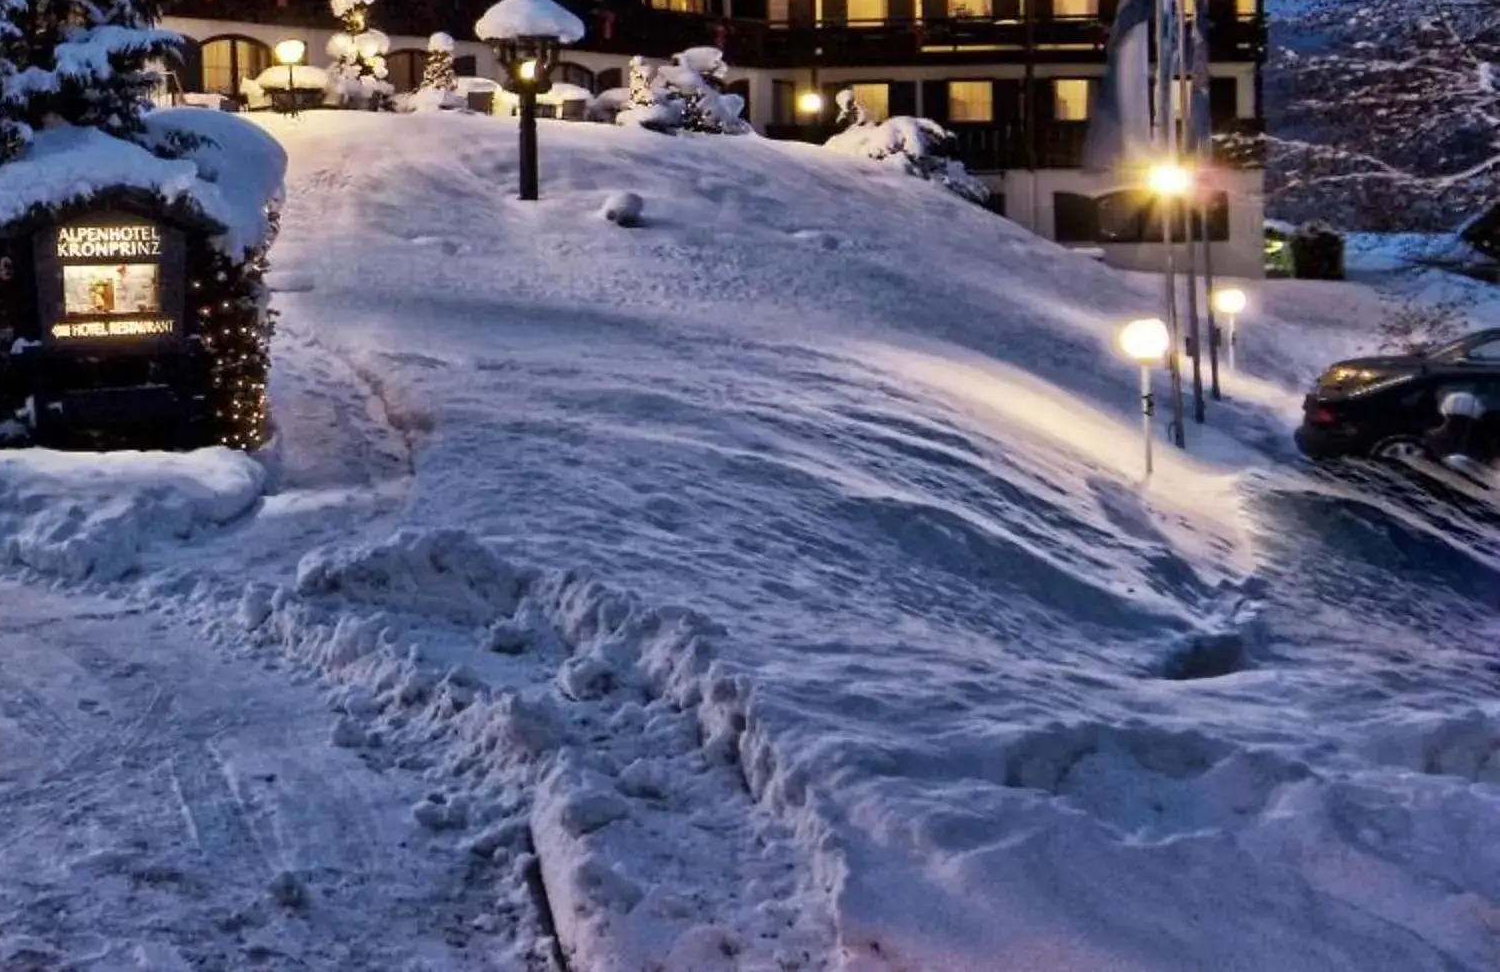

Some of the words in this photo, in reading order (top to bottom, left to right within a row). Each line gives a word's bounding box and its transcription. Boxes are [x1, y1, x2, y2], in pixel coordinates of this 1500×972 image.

[58, 225, 160, 242] ALPENHOTEL
[57, 241, 161, 257] KRONPRINZ
[71, 322, 108, 337] HOTEL
